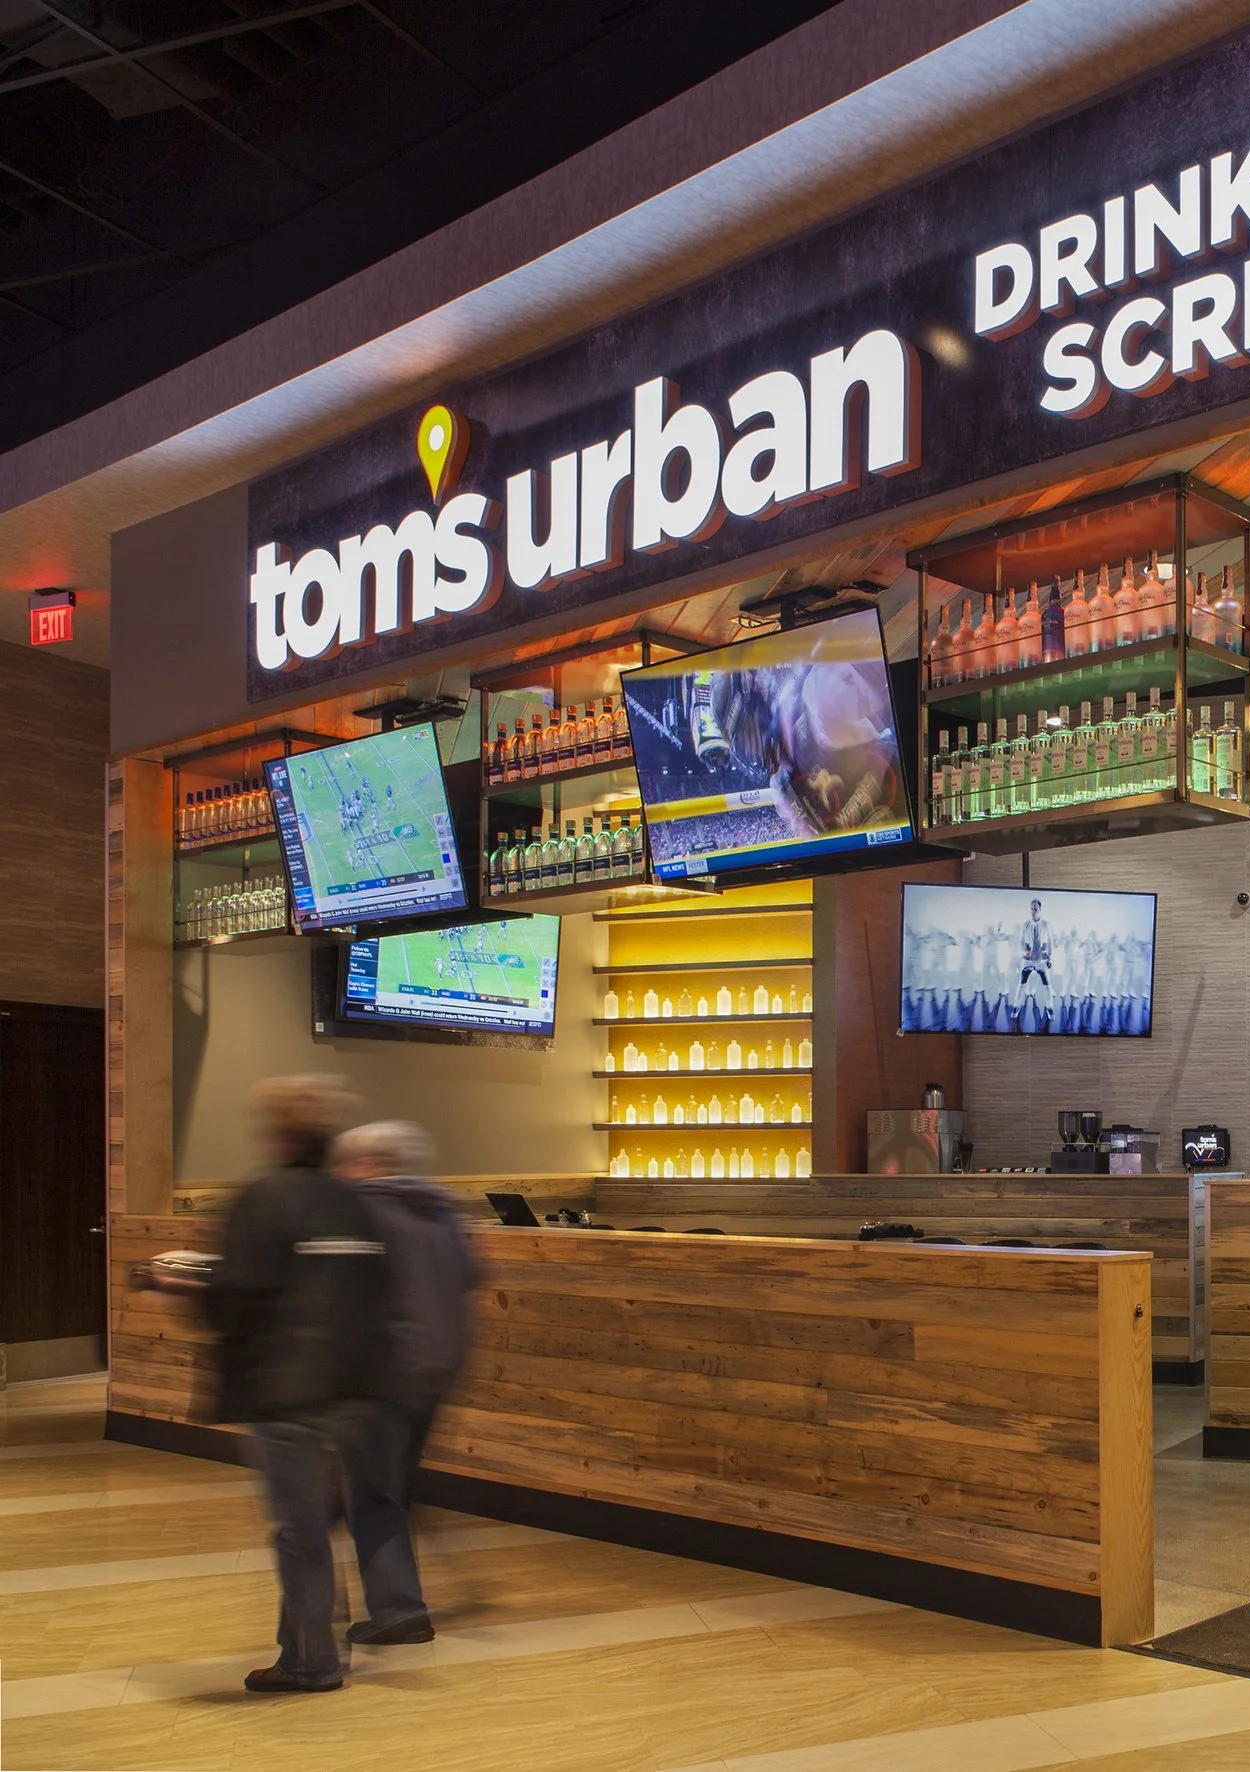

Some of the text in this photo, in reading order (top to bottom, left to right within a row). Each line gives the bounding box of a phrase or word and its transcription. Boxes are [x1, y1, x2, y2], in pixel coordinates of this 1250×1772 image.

[507, 329, 905, 588] urban
[39, 609, 66, 641] EXIT
[662, 863, 685, 873] NFL NEWS
